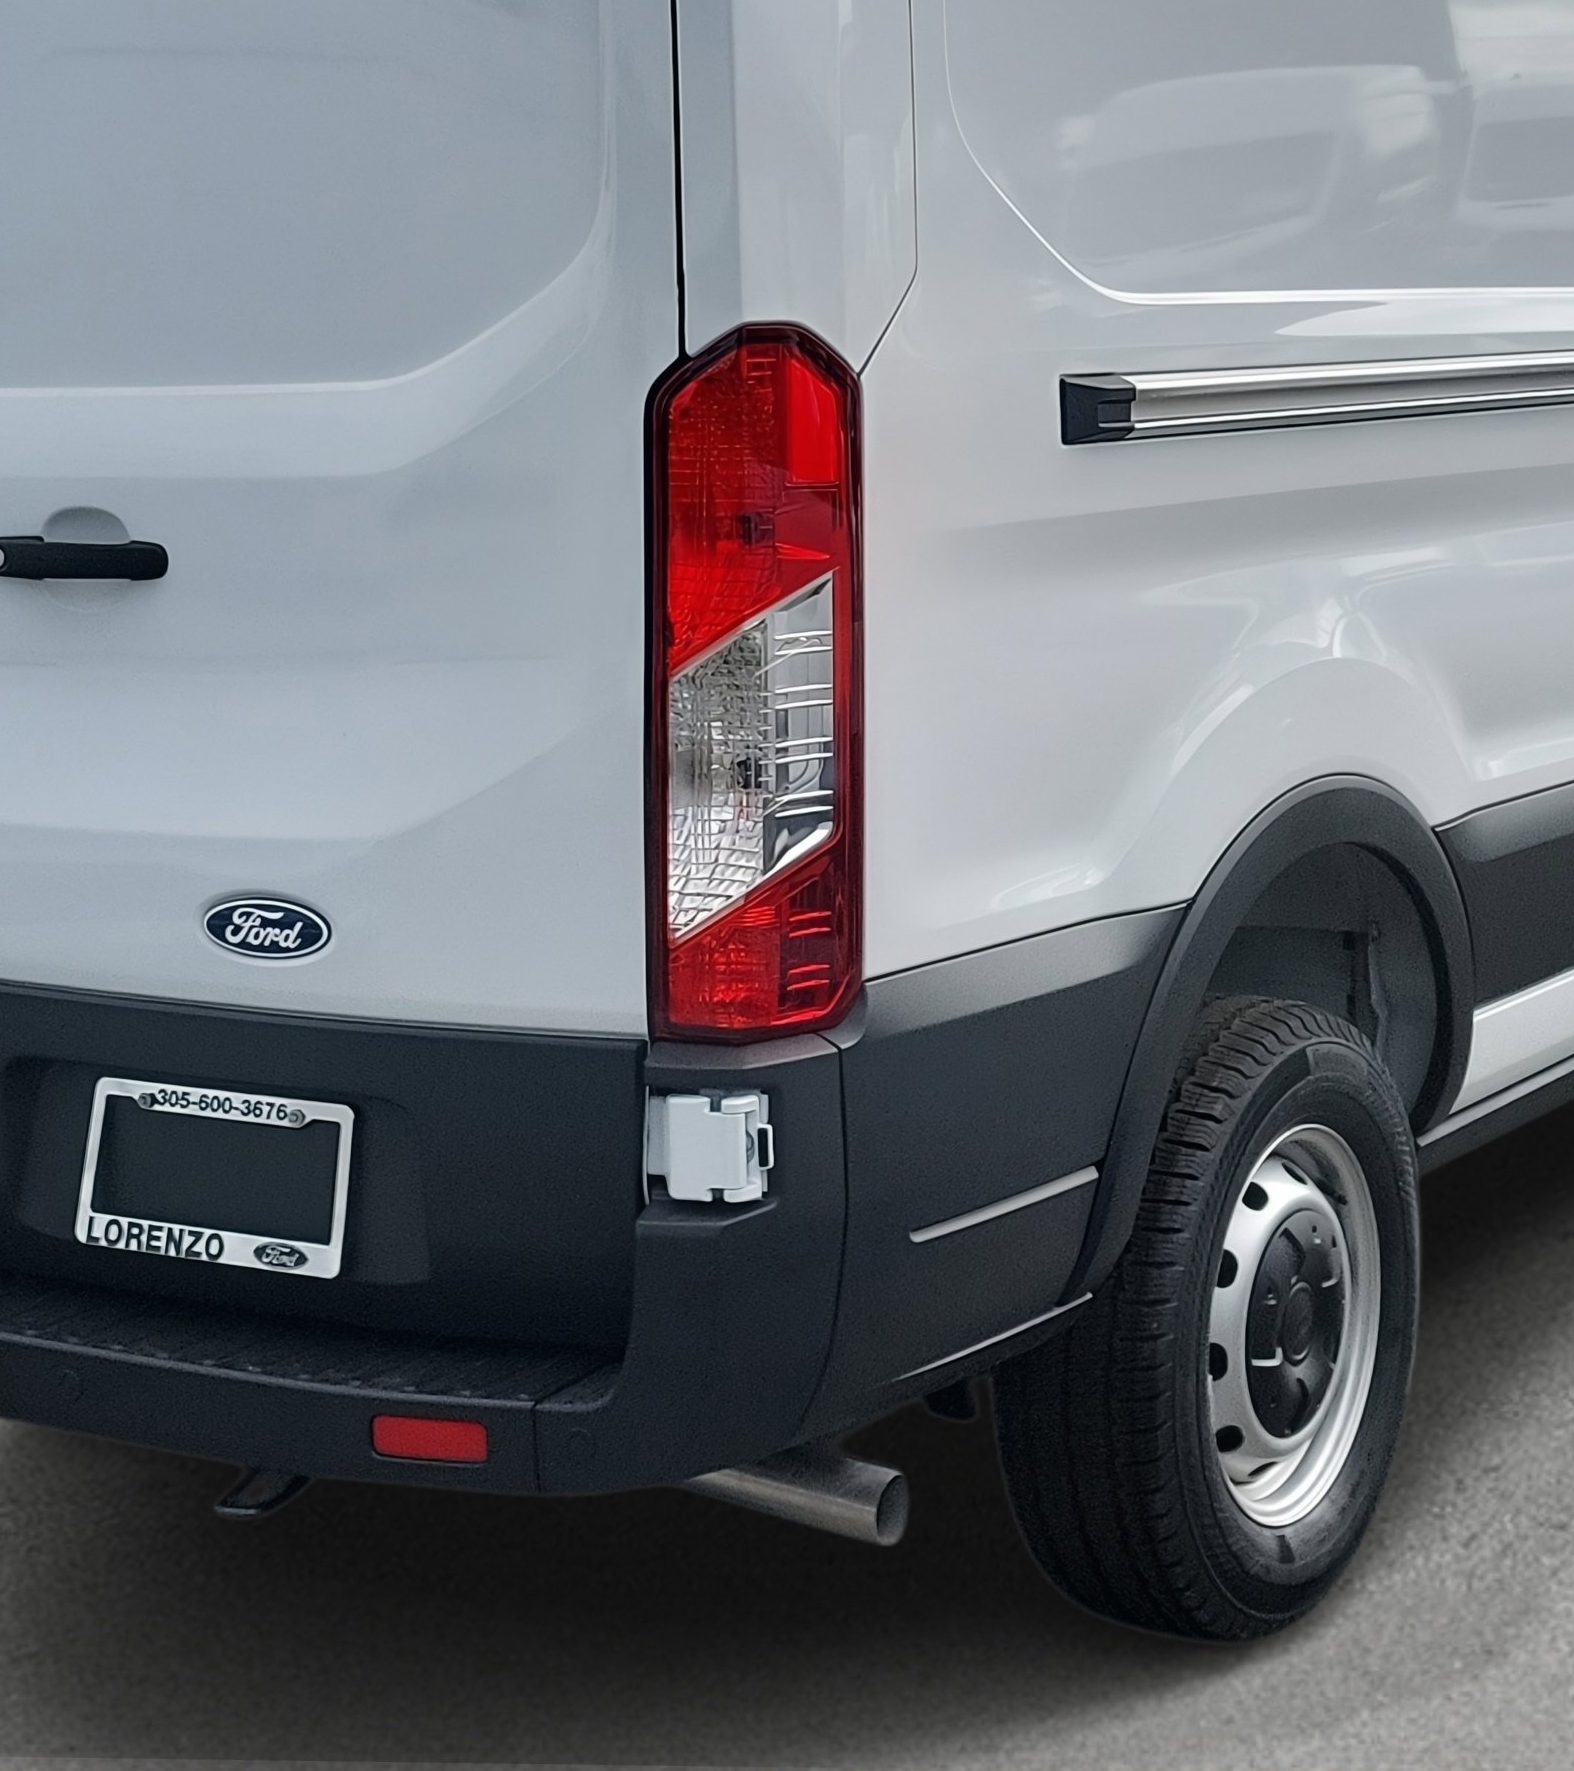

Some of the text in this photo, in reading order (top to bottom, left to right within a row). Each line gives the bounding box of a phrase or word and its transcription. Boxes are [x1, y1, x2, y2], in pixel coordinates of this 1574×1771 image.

[225, 907, 303, 948] Ford
[154, 1088, 288, 1121] 305-600-3676
[85, 1216, 300, 1267] LORENZO Ford
